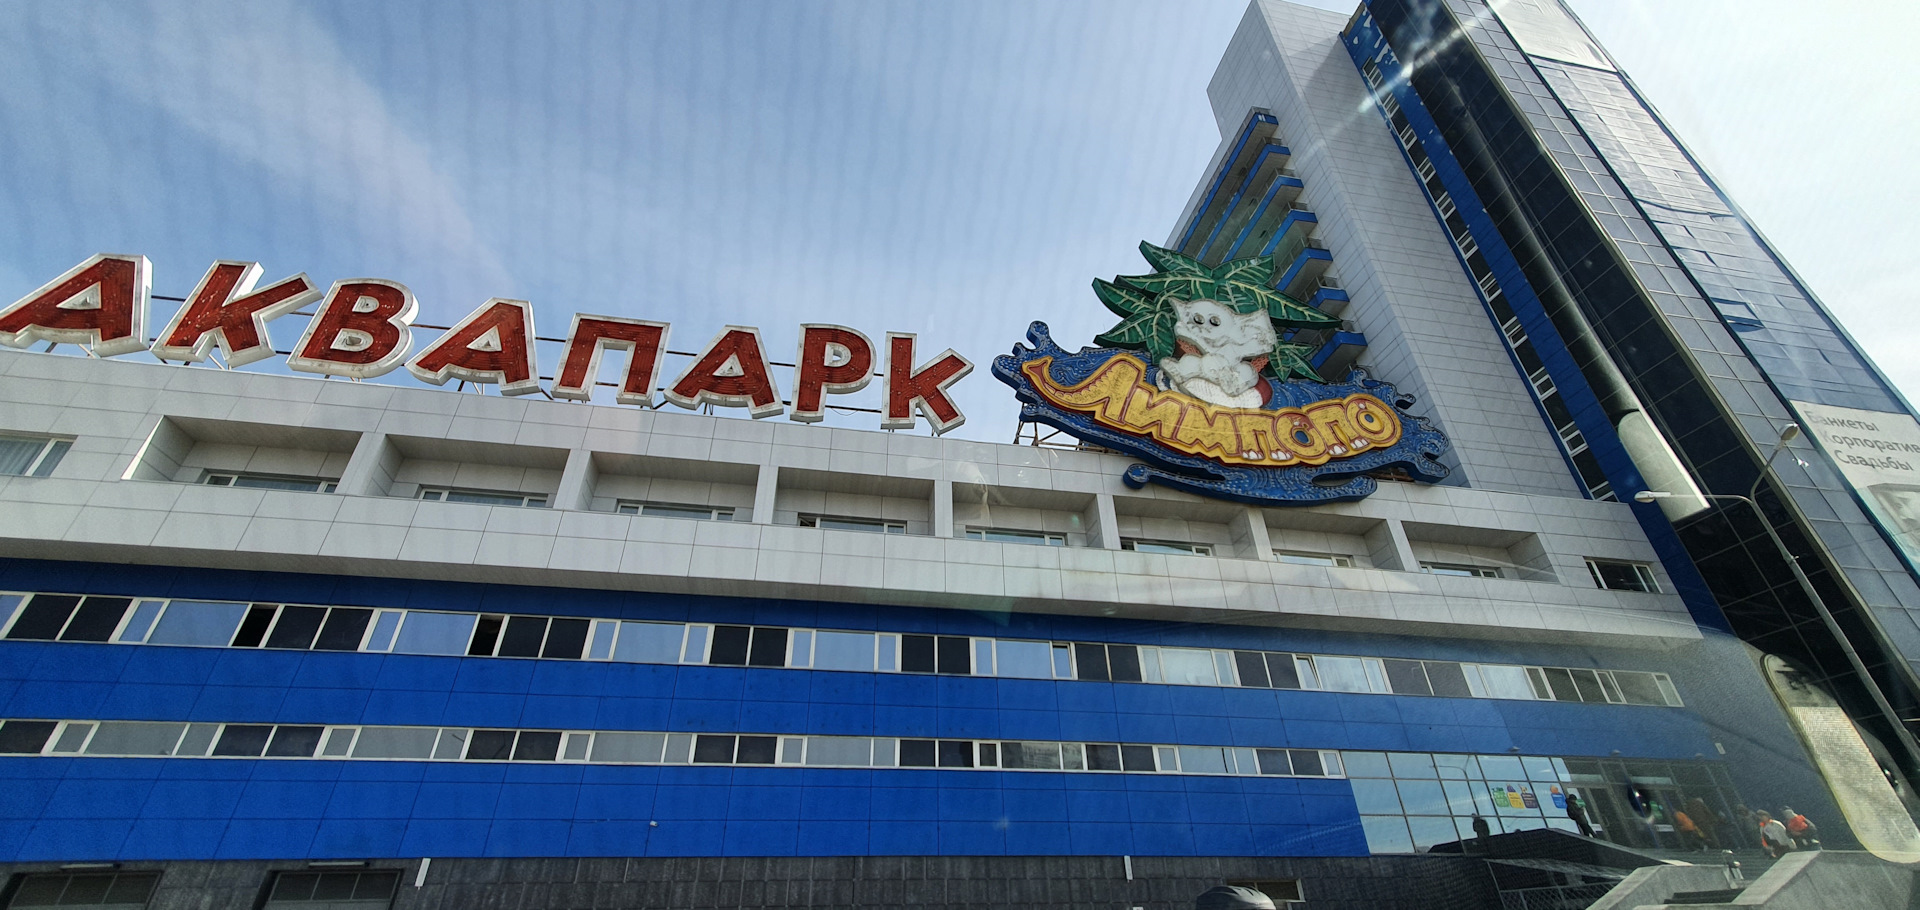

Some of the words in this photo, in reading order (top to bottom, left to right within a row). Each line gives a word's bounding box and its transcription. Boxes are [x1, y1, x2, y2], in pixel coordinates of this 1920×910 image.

[0, 253, 974, 436] АКВАПАРК
[1803, 410, 1880, 432] Банкеты
[1834, 449, 1914, 471] Свадьбы
